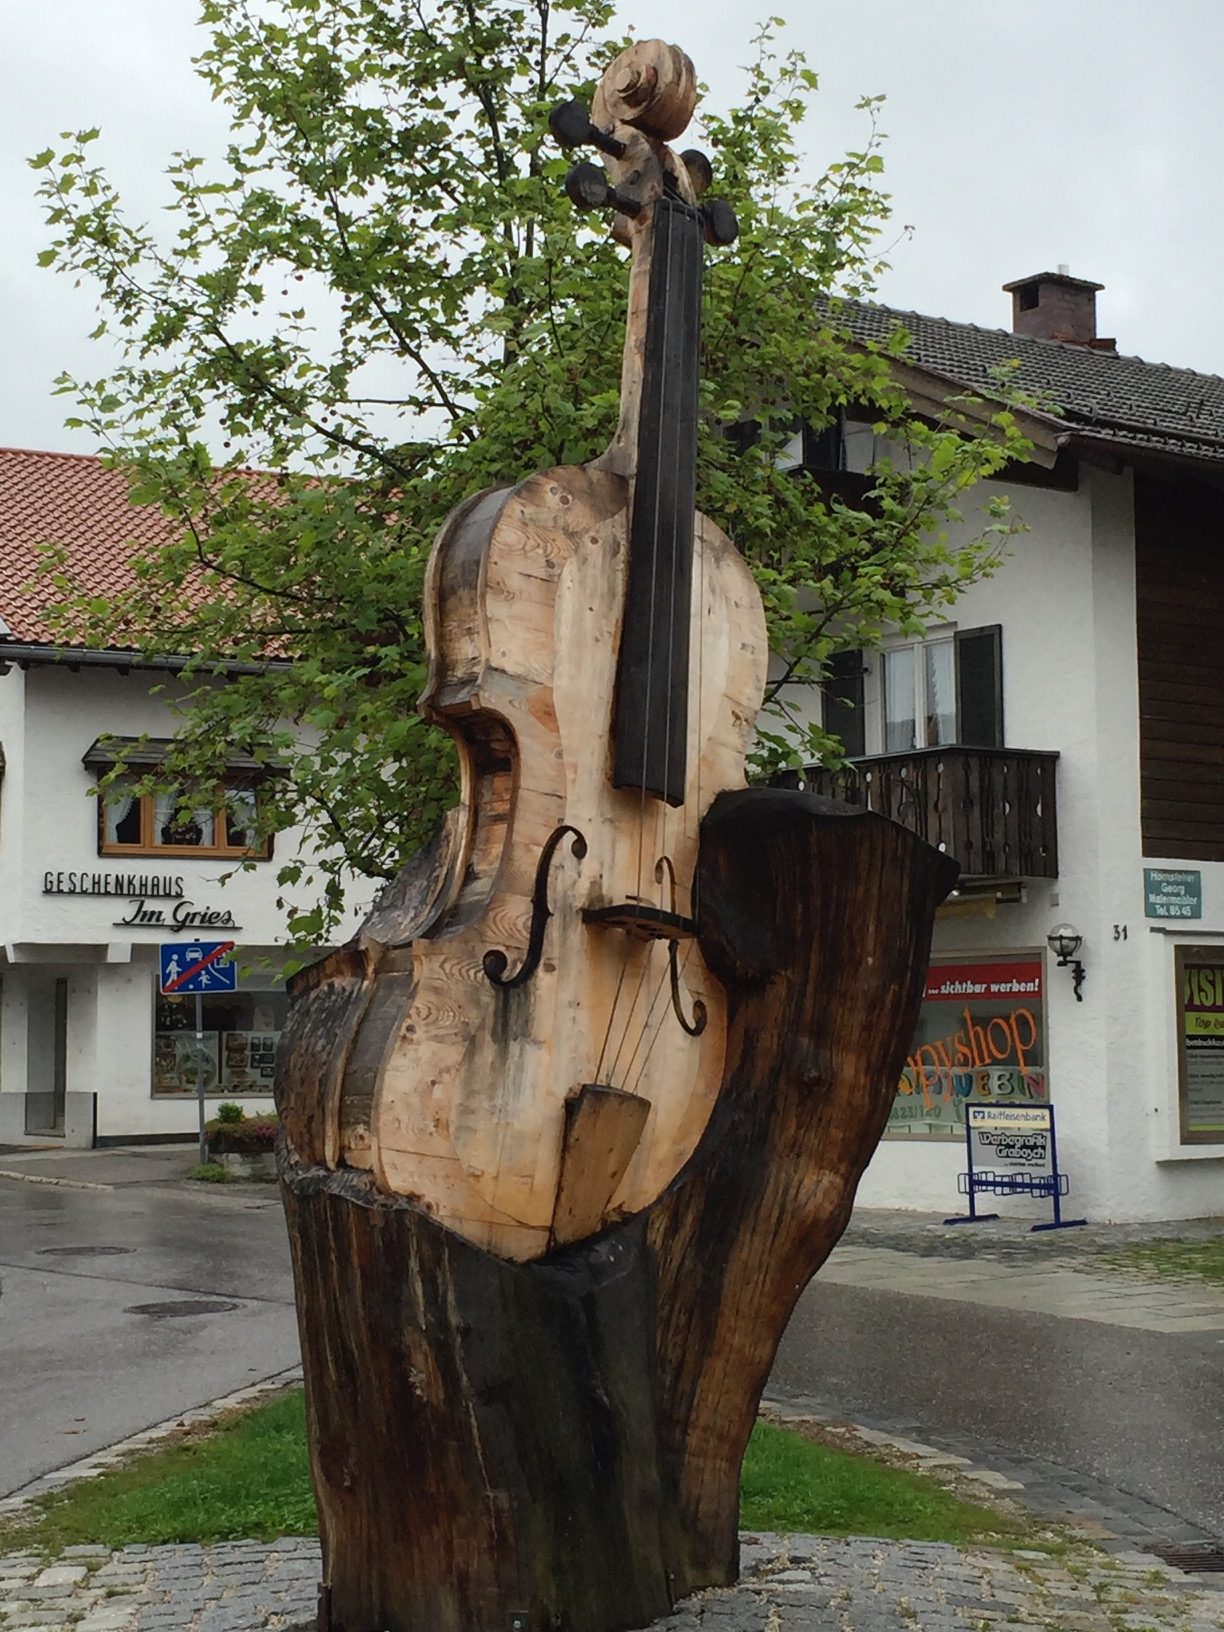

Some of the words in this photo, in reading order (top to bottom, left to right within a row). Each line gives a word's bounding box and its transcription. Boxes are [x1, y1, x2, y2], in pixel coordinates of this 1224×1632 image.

[44, 871, 184, 897] GESCHENKHAUS
[1161, 883, 1185, 895] Georg
[122, 899, 165, 925] Im
[170, 901, 235, 932] Gries
[1113, 925, 1128, 941] 31
[990, 978, 1040, 992] werben!
[907, 1006, 1037, 1110] pyshop
